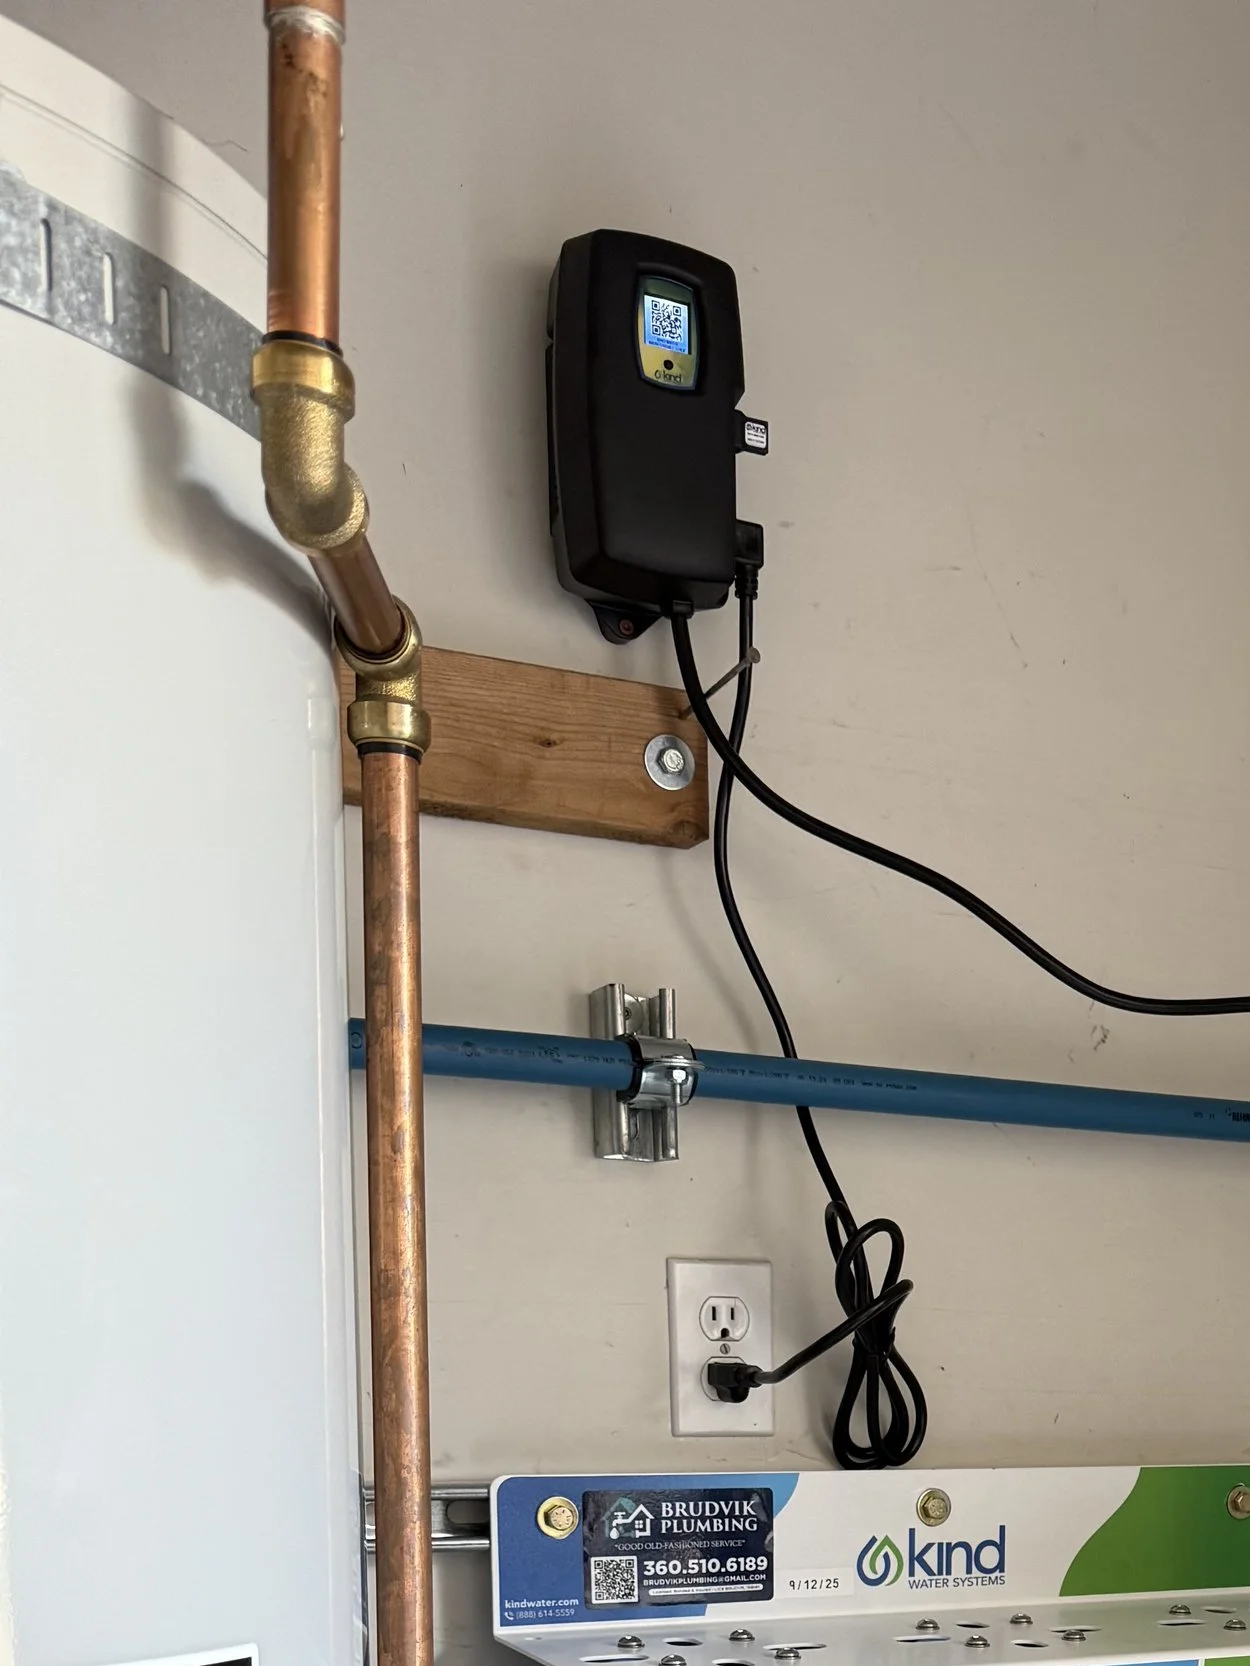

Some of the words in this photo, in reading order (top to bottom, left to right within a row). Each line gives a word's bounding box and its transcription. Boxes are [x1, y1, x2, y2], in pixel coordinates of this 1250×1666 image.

[661, 1500, 757, 1518] BRUDVIK
[661, 1517, 758, 1534] PLUMBING
[908, 1525, 1006, 1577] kind
[643, 1556, 768, 1576] 360.510.6189
[643, 1574, 766, 1586] BRUDVIKPLUMBING@GMAIL.COM
[909, 1579, 949, 1590] WATER
[953, 1576, 1006, 1588] SYSTEMS
[504, 1598, 579, 1609] kindwater.com
[516, 1610, 536, 1620] (888)
[538, 1608, 575, 1618] 614-5559
